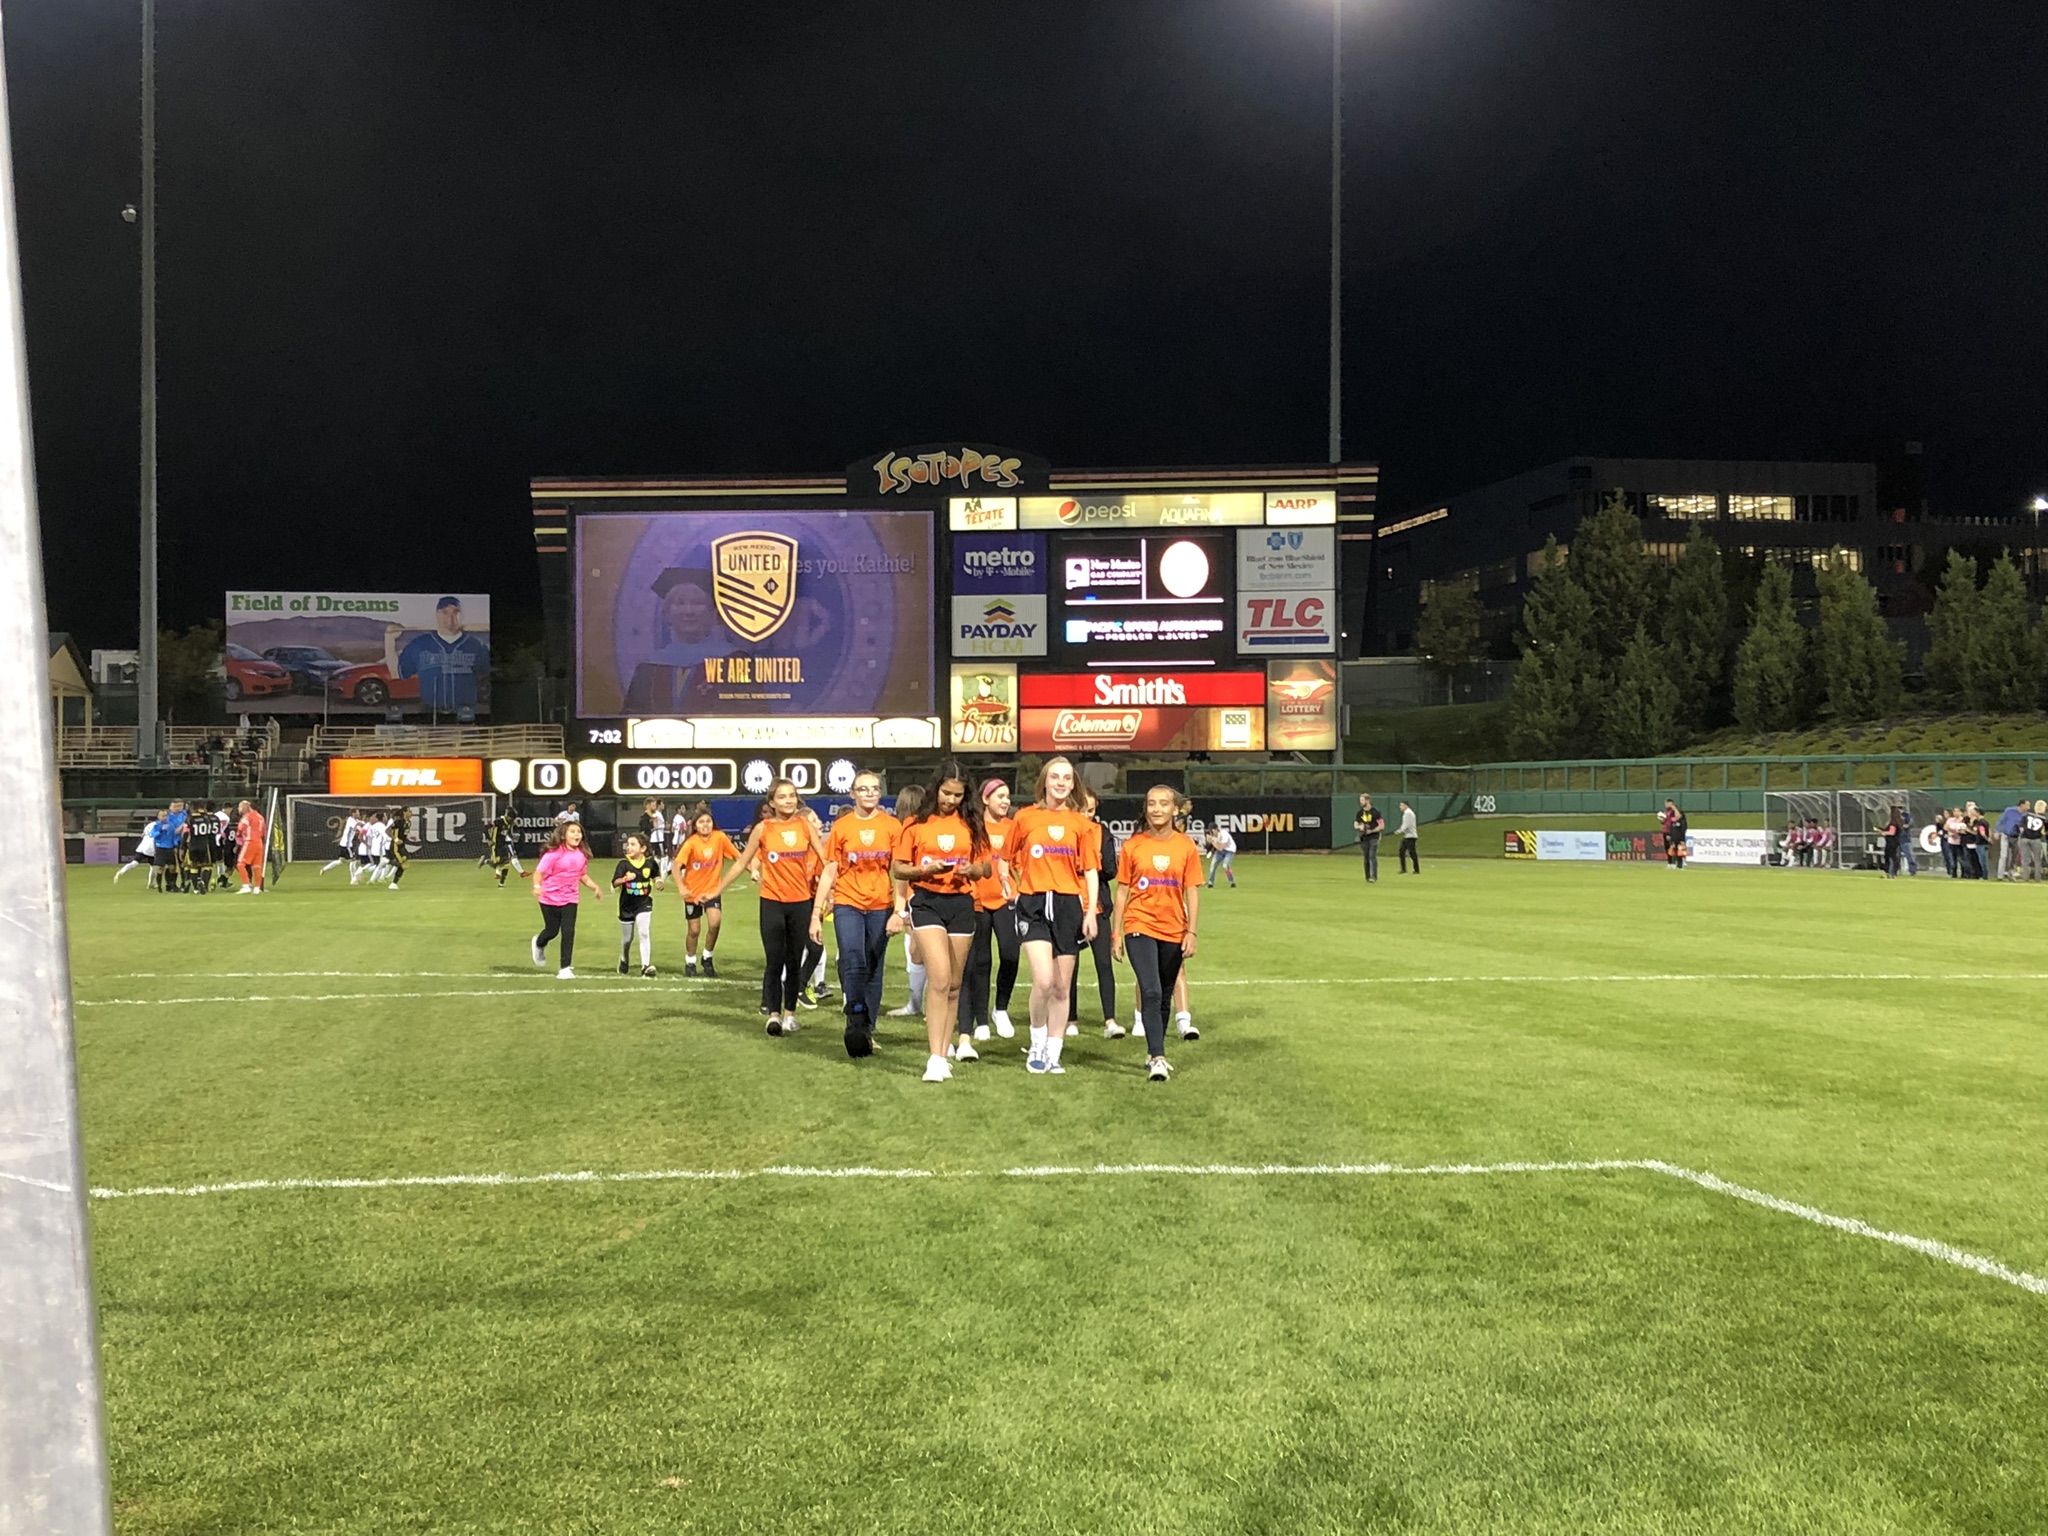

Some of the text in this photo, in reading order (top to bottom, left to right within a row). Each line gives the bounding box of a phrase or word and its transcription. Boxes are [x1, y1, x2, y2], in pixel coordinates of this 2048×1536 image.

[1085, 502, 1137, 521] pepsi
[1269, 498, 1318, 510] AARP
[965, 508, 1005, 526] TECATE
[728, 553, 781, 572] UNITED
[965, 547, 1035, 567] metro
[231, 594, 399, 613] Field of Dreams
[1247, 598, 1325, 628] TLC
[960, 624, 1038, 639] PAYDAY
[971, 638, 1024, 654] HCM
[704, 657, 805, 683] WE ARE UNITED.
[1094, 674, 1186, 706] Smith's
[1281, 705, 1321, 714] LOTTERY
[1061, 715, 1121, 733] Coleman
[590, 730, 622, 743] 7:02
[371, 768, 442, 786] STIHL
[540, 765, 558, 788] 0
[637, 766, 713, 789] 00:00
[791, 766, 808, 788] 0
[1474, 795, 1496, 812] 428
[192, 823, 208, 836] 10
[405, 806, 467, 853] ite
[1215, 814, 1294, 833] ENDWI
[2027, 815, 2043, 831] 19
[228, 830, 236, 841] 8
